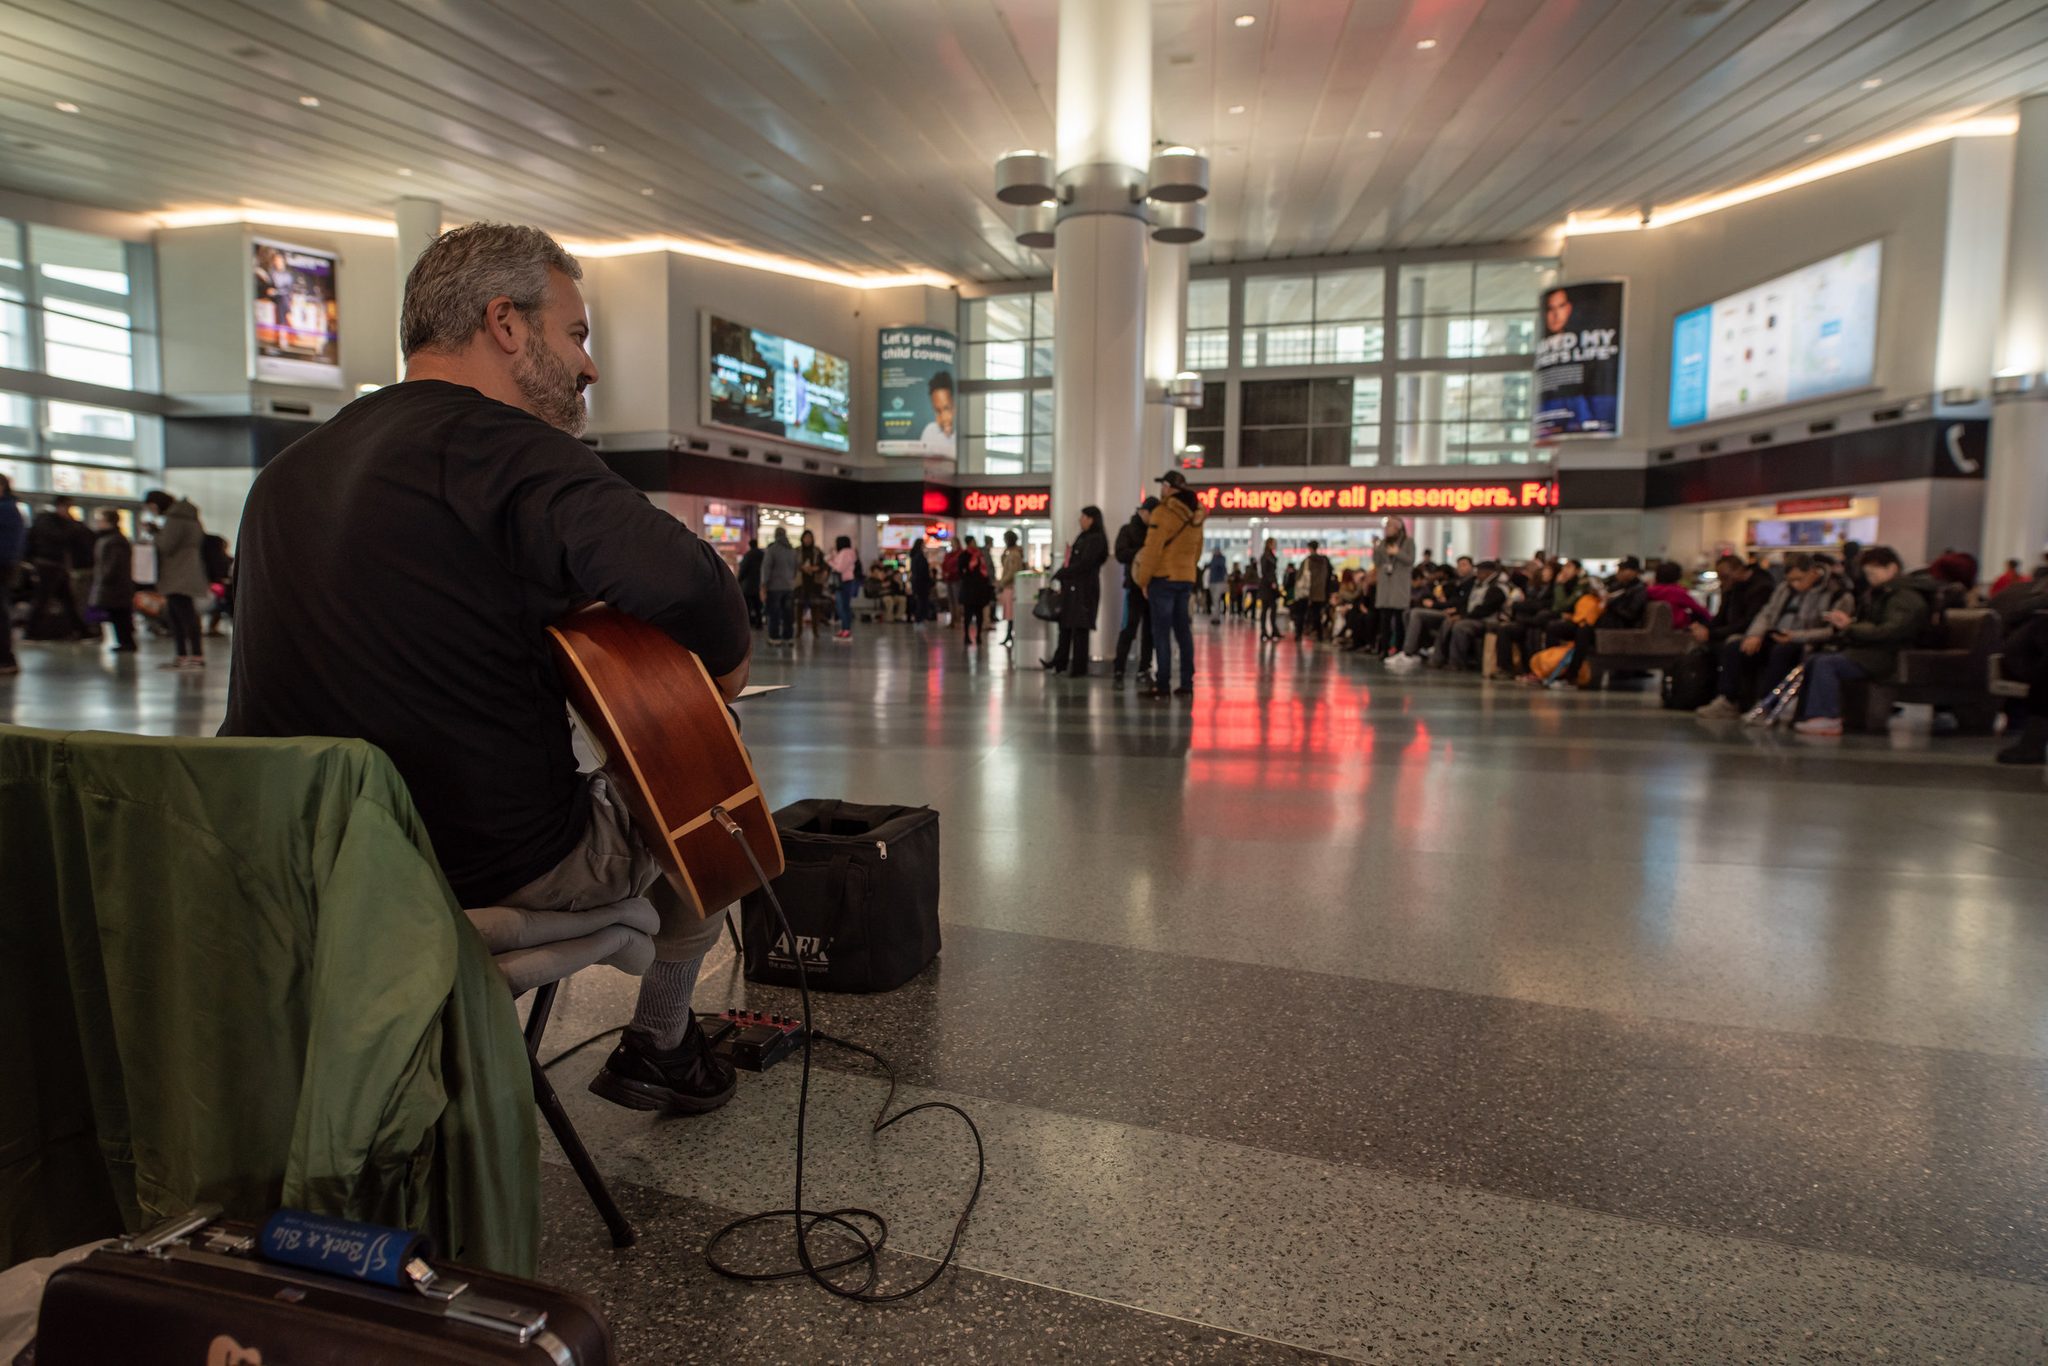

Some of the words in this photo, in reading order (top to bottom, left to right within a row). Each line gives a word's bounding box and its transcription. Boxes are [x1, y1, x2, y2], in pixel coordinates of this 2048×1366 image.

[882, 331, 910, 345] Let's
[912, 334, 933, 347] get
[881, 347, 911, 360] child
[965, 491, 1011, 514] days
[1014, 494, 1048, 515] per
[1197, 487, 1219, 509] of
[1219, 487, 1297, 513] charge
[1300, 486, 1336, 507] for
[1337, 485, 1366, 508] all
[1369, 486, 1517, 513] passengers.
[307, 1231, 320, 1248] &
